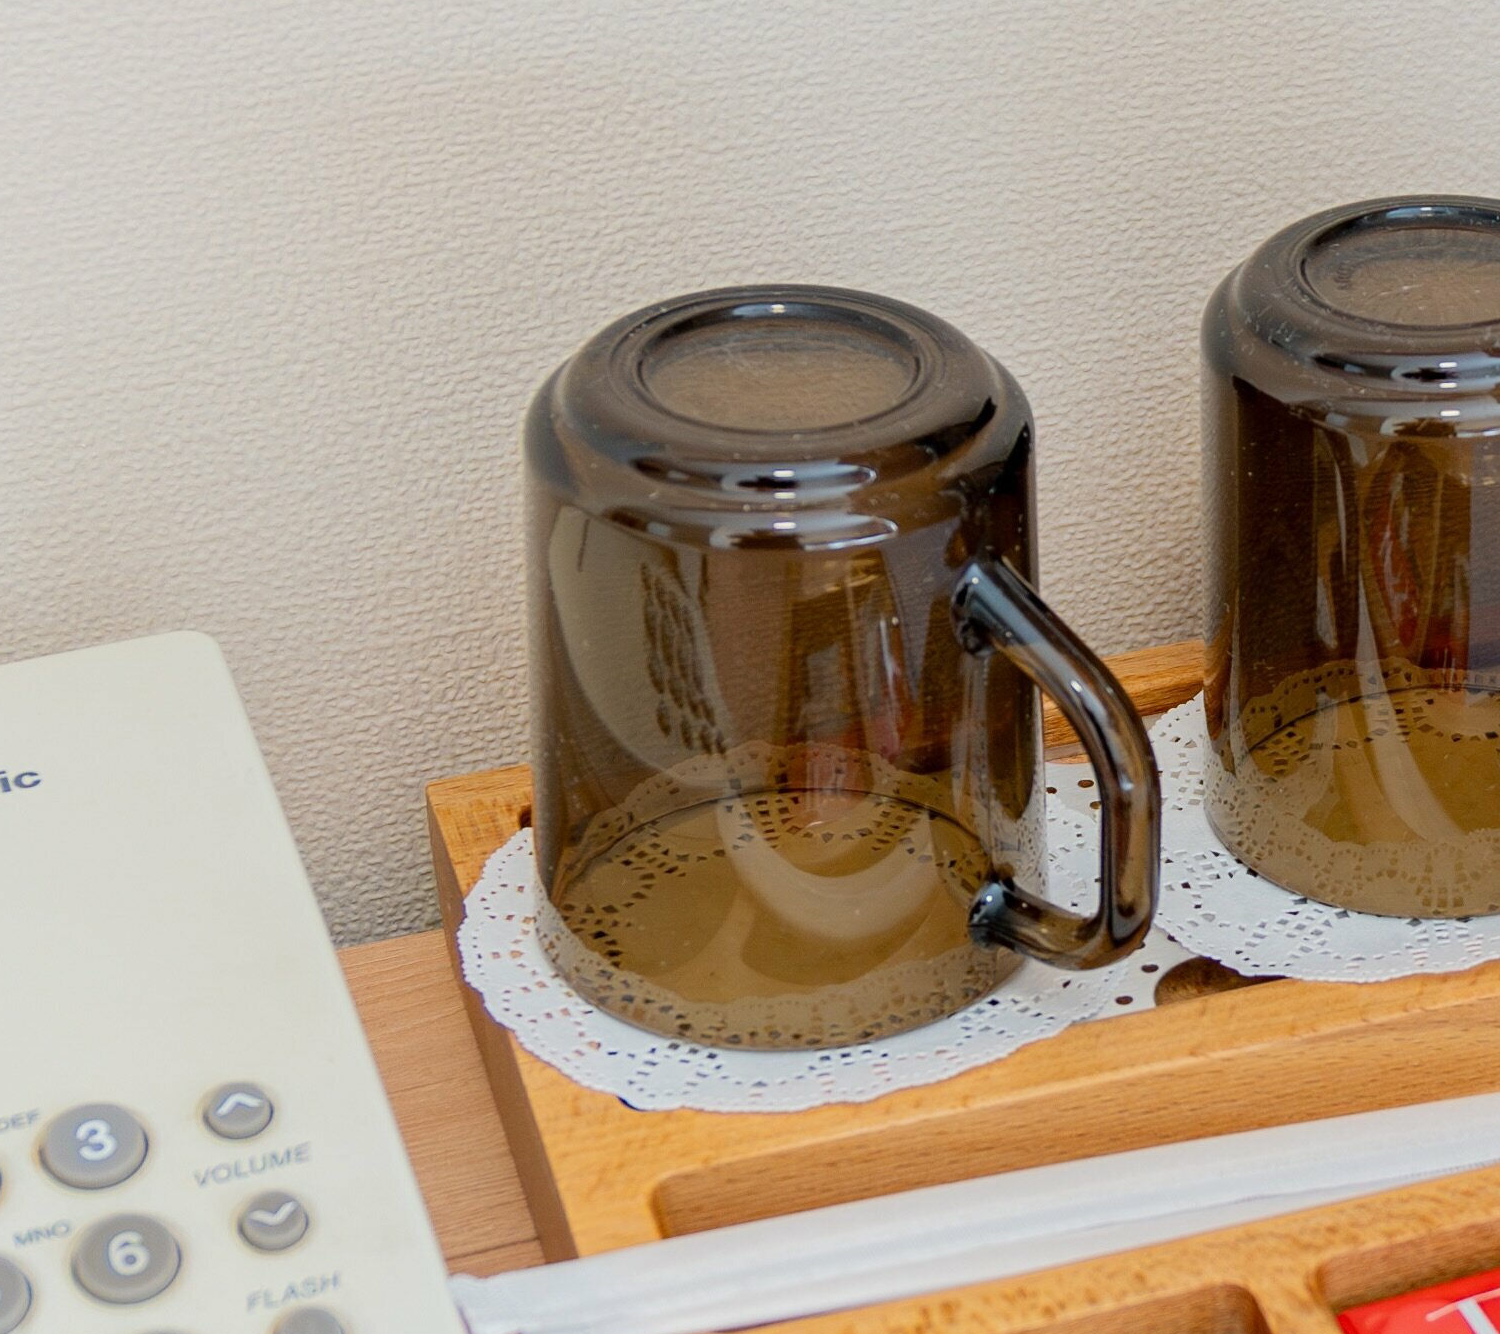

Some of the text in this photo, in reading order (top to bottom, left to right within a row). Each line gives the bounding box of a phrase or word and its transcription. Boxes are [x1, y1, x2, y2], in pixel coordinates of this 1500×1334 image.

[74, 1118, 118, 1162] 3
[193, 1141, 312, 1188] VOLUME
[12, 1219, 72, 1249] MNO
[107, 1230, 149, 1276] 6
[246, 1272, 341, 1313] FLASH
